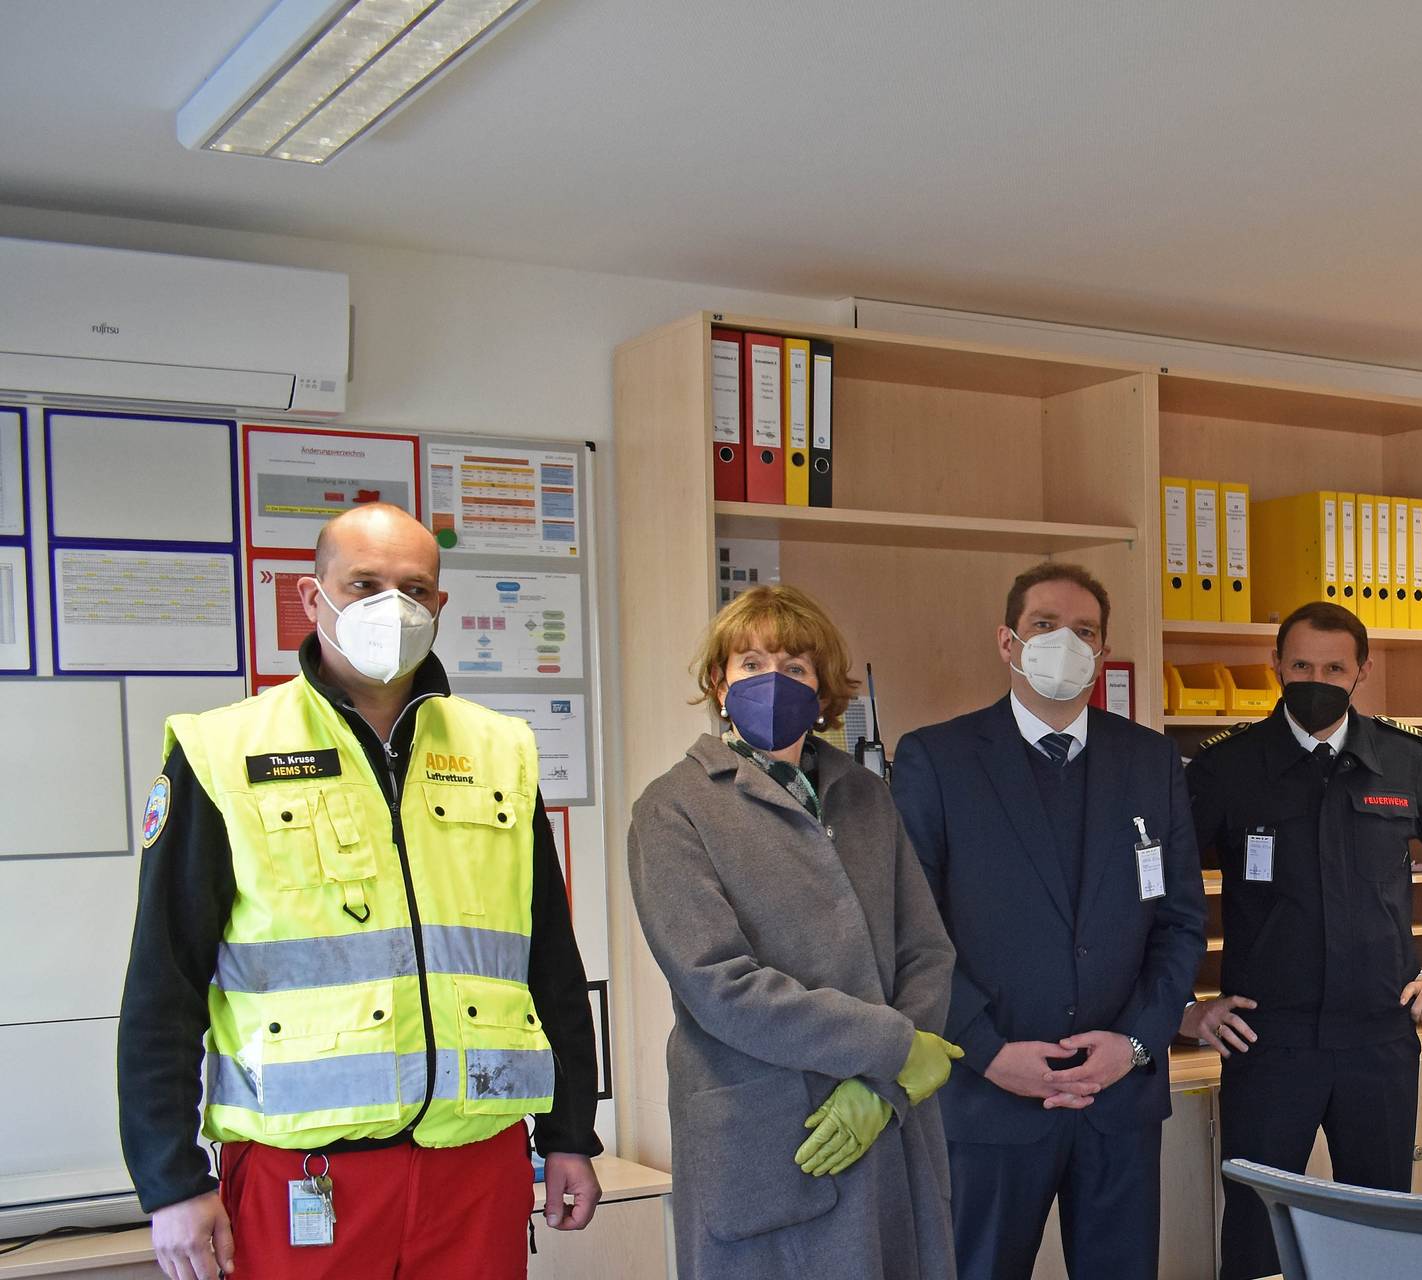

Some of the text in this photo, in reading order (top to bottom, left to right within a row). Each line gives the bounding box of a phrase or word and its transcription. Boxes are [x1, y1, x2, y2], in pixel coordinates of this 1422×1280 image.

[92, 323, 120, 335] FUJITSU
[301, 446, 366, 458] Änderungsverzeichnis
[270, 755, 315, 765] Th. Kruse
[425, 752, 472, 773] ADAC
[273, 766, 301, 776] HEMS
[303, 765, 317, 775] TC
[426, 771, 474, 784] Luftrettung
[1363, 796, 1409, 808] FEUERWEHR
